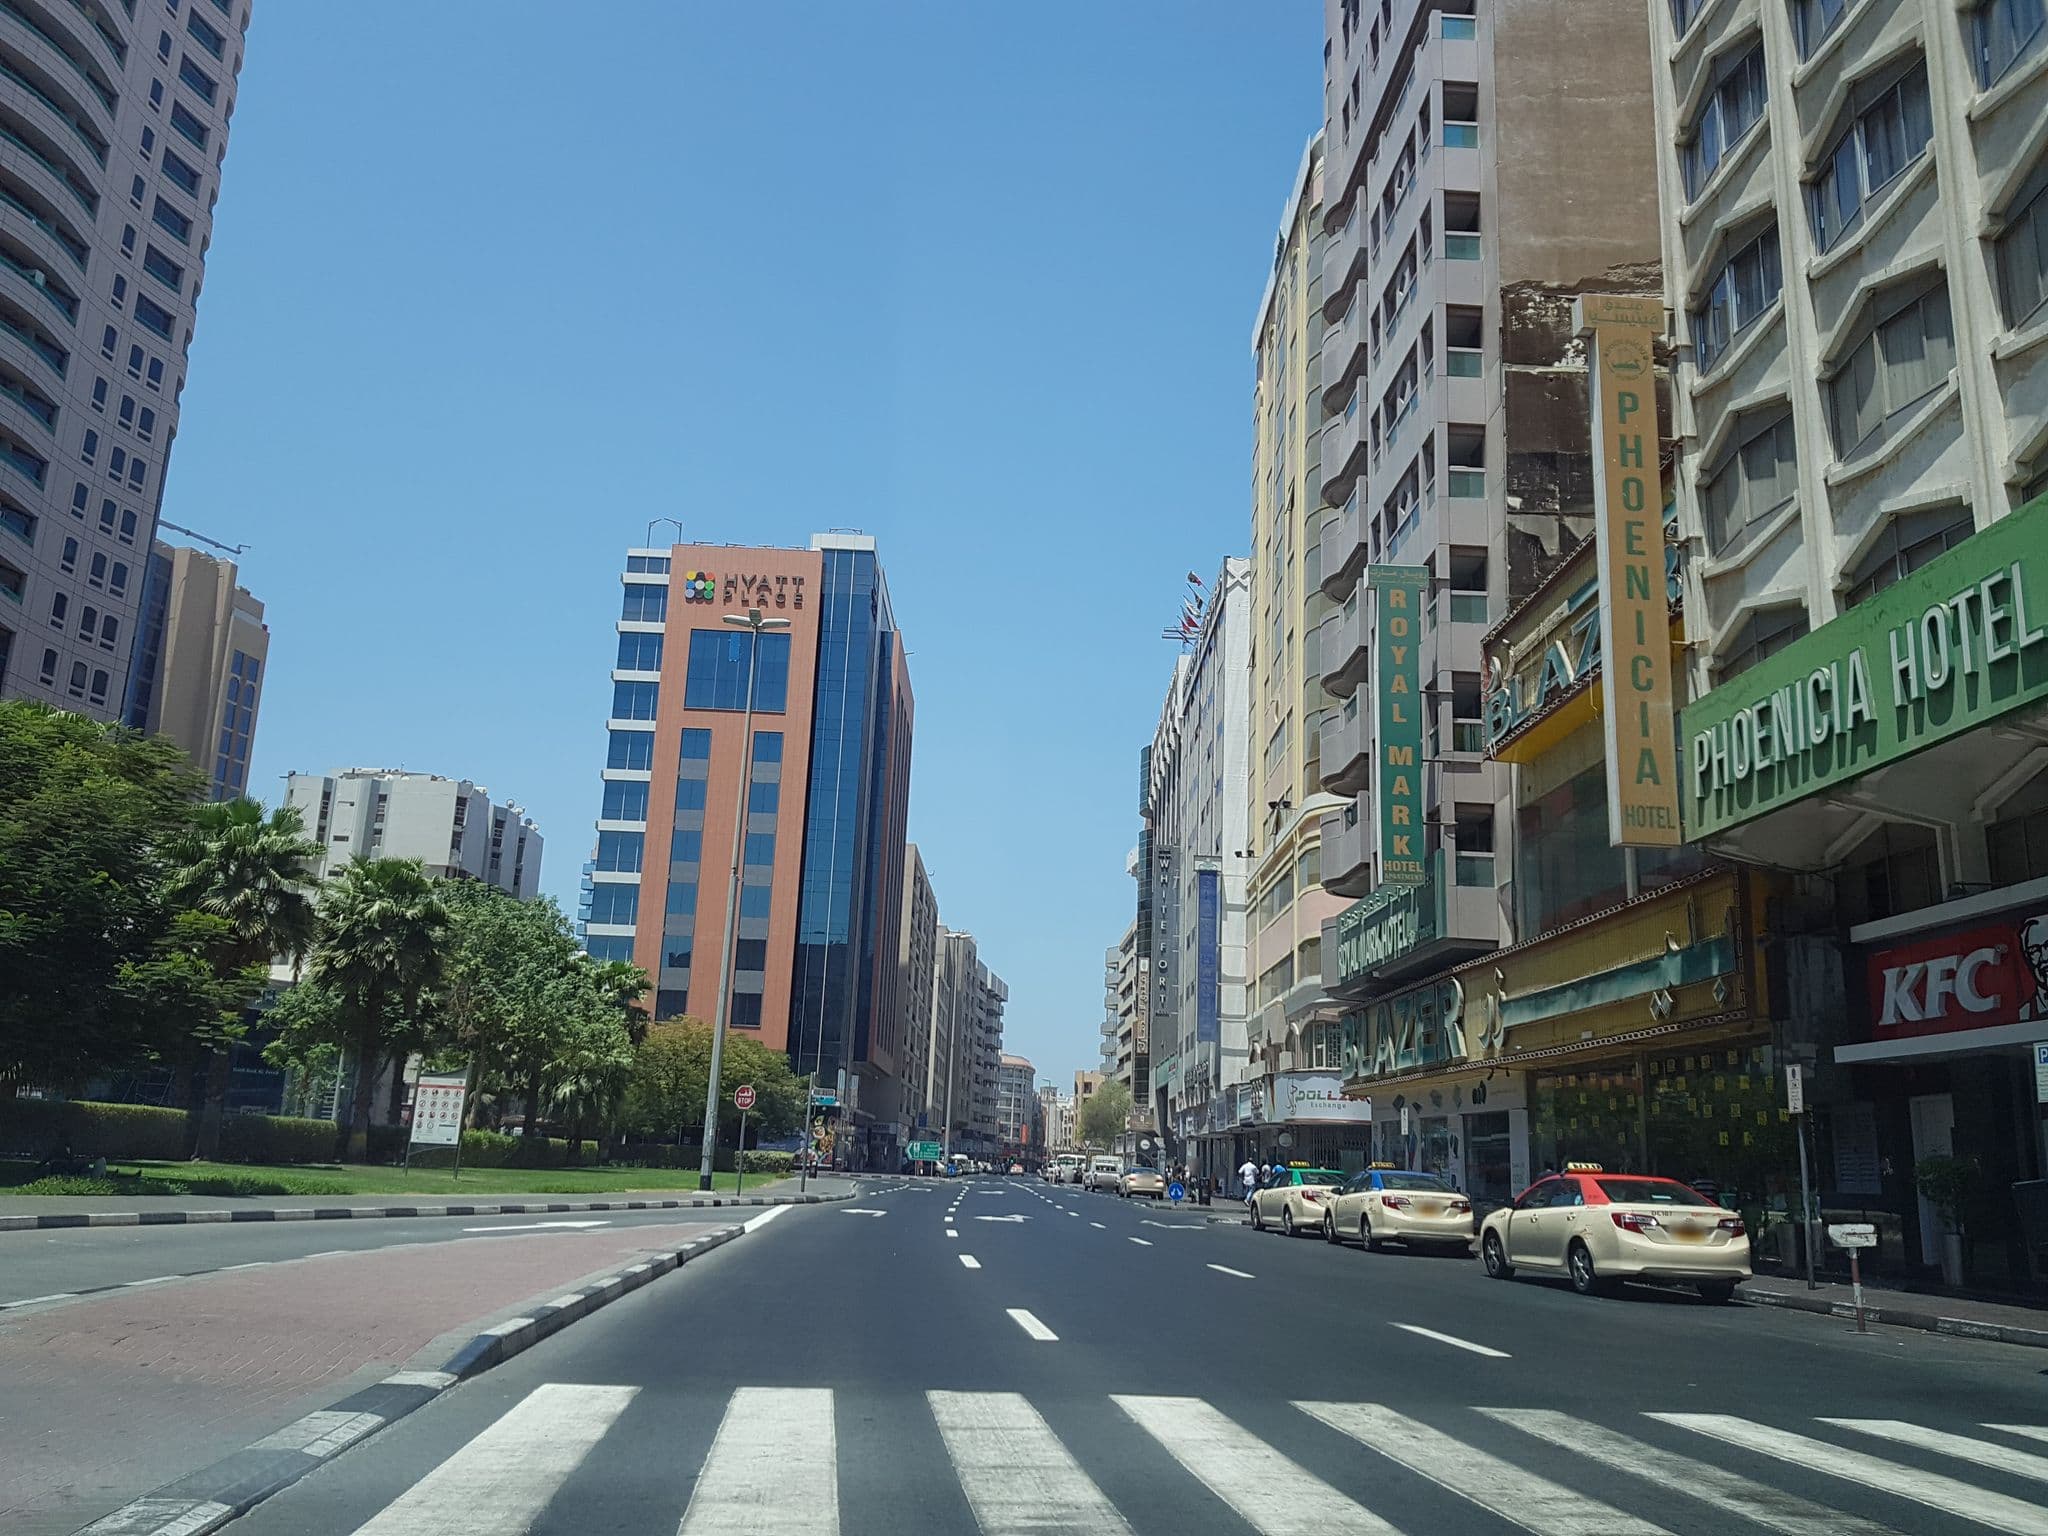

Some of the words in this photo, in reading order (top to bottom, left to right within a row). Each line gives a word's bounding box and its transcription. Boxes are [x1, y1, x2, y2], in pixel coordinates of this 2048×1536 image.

[723, 590, 804, 609] PLACE
[724, 573, 805, 594] HYATT
[1617, 391, 1661, 785] PHOENICIA
[1389, 589, 1408, 723] ROYAL
[1694, 648, 1876, 798] PHOENICIA
[1889, 561, 2046, 707] HOTEL
[1388, 745, 1413, 856] MARK
[1624, 804, 1676, 830] HOTEL
[1159, 859, 1169, 930] WHITE
[1383, 860, 1423, 872] HOTEL
[1158, 943, 1168, 1004] FORT
[1878, 946, 2001, 1026] KFC
[1340, 976, 1468, 1080] BLAZER
